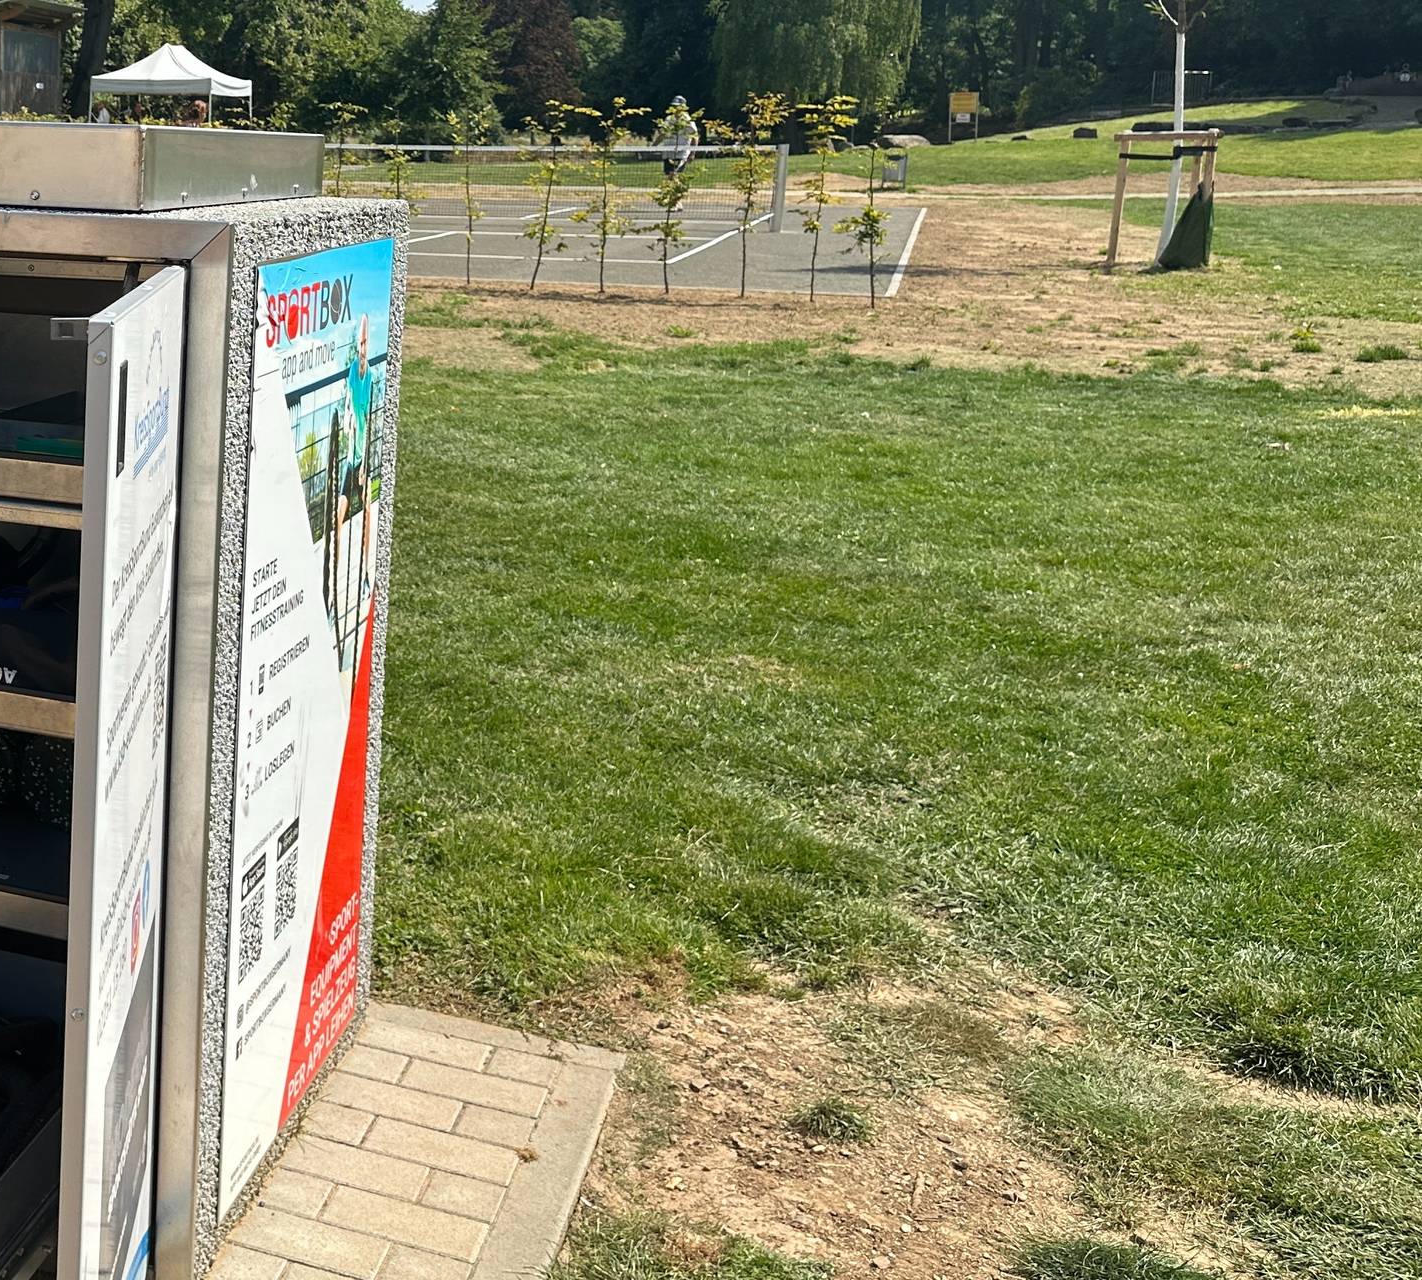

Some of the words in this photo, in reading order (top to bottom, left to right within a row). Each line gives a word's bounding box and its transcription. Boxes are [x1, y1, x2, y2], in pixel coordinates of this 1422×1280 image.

[266, 273, 353, 348] SPORTBOX
[282, 354, 296, 384] app
[299, 343, 314, 373] and
[315, 341, 335, 366] move
[252, 587, 271, 614] JETZT
[272, 578, 286, 600] DEIN
[253, 558, 278, 588] STARTE
[251, 589, 304, 640] FITNESSTRAINING
[249, 680, 254, 695] 1
[269, 635, 310, 680] REGISTRIEREN
[246, 732, 252, 748] 2
[267, 696, 291, 730] BUCHEN
[244, 784, 250, 800] 3
[265, 740, 295, 781] LOSLEGEN
[329, 892, 359, 945] SPORT-
[310, 922, 357, 1007] EQUIPMENT
[304, 1023, 311, 1047] &
[312, 956, 355, 1035] SPIELZEUG
[288, 1063, 306, 1106] PER
[306, 1033, 325, 1077] APP
[326, 988, 354, 1047] LEIHEN
